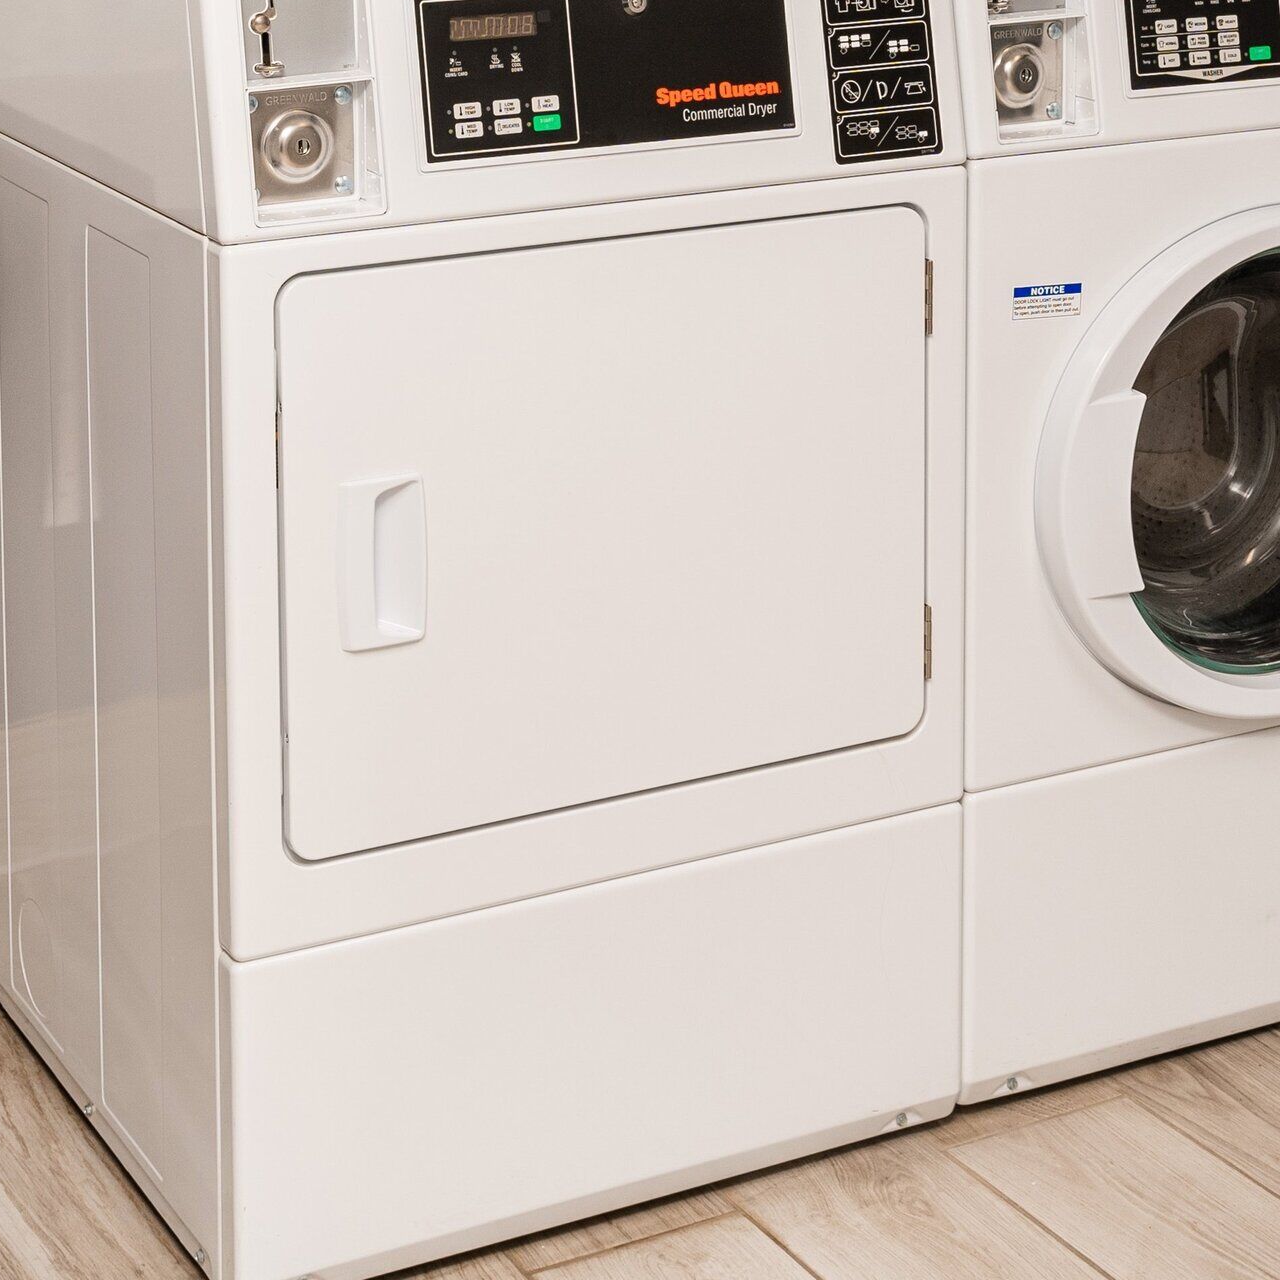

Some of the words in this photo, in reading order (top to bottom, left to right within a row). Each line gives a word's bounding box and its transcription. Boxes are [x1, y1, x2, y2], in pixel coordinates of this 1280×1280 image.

[994, 27, 1043, 39] GREENWALD
[1202, 69, 1224, 77] WASHER
[265, 91, 327, 106] GREENWALD
[656, 83, 716, 107] Speed
[719, 81, 779, 98] Queen
[683, 105, 745, 122] Commercial
[748, 103, 778, 118] Dryer
[1031, 286, 1065, 295] NOTICE
